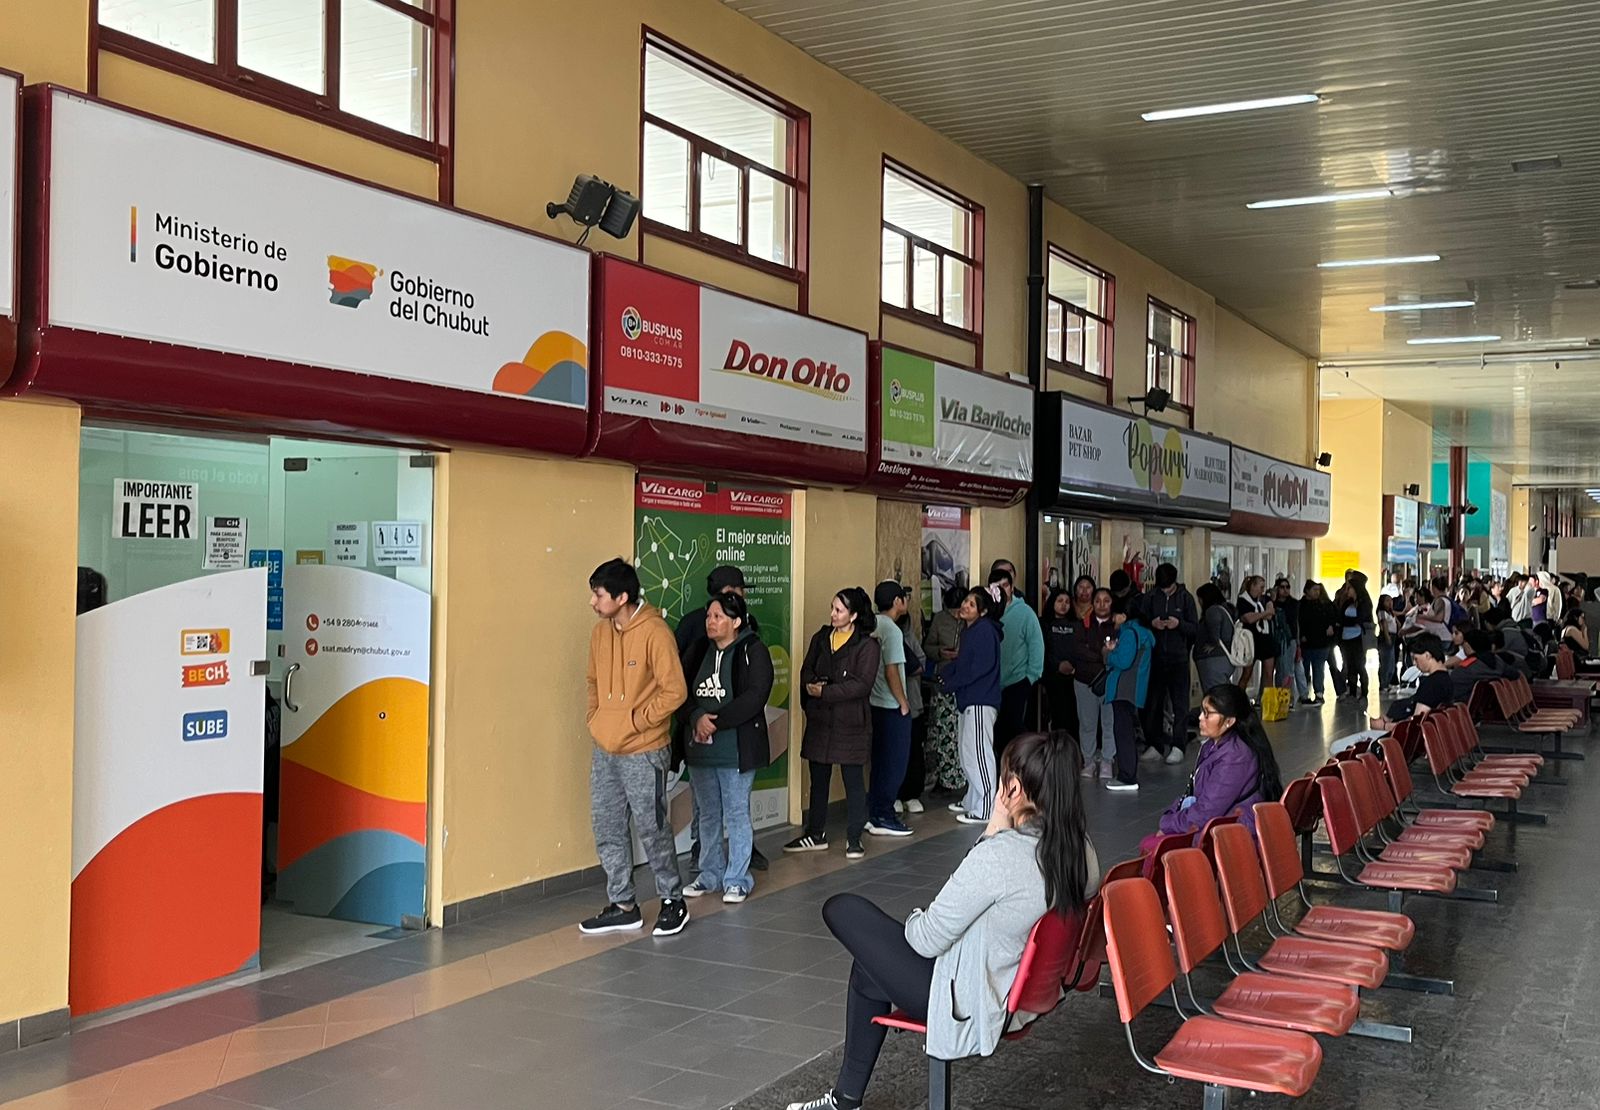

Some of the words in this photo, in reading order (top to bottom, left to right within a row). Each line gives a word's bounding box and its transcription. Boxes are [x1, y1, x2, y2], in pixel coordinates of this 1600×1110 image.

[155, 212, 259, 255] Ministerio
[264, 240, 287, 261] de
[155, 243, 279, 291] Gobierno
[390, 270, 475, 309] Gobierno
[390, 296, 418, 322] del
[423, 303, 490, 337] Chubut
[642, 319, 683, 341] BUSPLUS
[620, 345, 683, 369] 0810-333-7575
[723, 338, 789, 381] Don
[791, 357, 851, 393] Otto
[630, 398, 649, 407] TAC
[940, 396, 968, 421] Via
[970, 404, 1032, 437] Bariloche
[1068, 423, 1093, 444] BAZAR
[1068, 441, 1083, 459] PET
[1083, 444, 1102, 462] SHOP
[878, 461, 912, 476] Destinos
[123, 481, 193, 500] IMPORTANTE
[667, 487, 703, 499] CARGO
[752, 495, 784, 505] CARGO
[121, 501, 191, 539] LEER
[716, 528, 726, 543] El
[728, 529, 755, 548] mejor
[756, 530, 791, 546] servicio
[716, 546, 746, 562] online
[188, 664, 224, 682] BECH
[186, 718, 224, 737] SUBE
